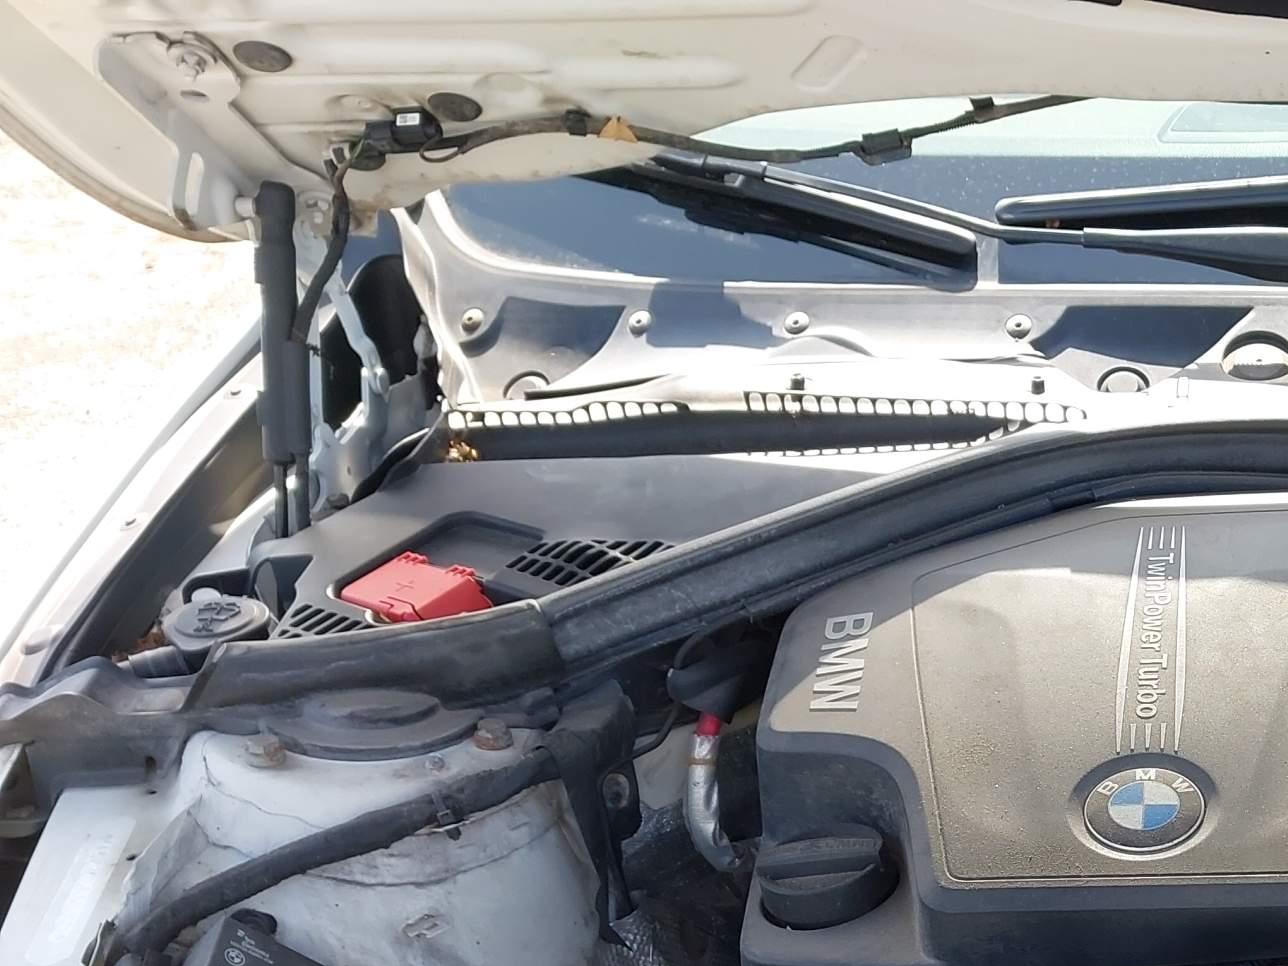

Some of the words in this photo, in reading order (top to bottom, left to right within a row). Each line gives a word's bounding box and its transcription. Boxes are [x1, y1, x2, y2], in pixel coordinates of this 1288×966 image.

[1140, 552, 1175, 651] TwinPower
[809, 612, 874, 712] BMW
[1135, 653, 1168, 720] Turbo
[1096, 768, 1195, 797] BMW
